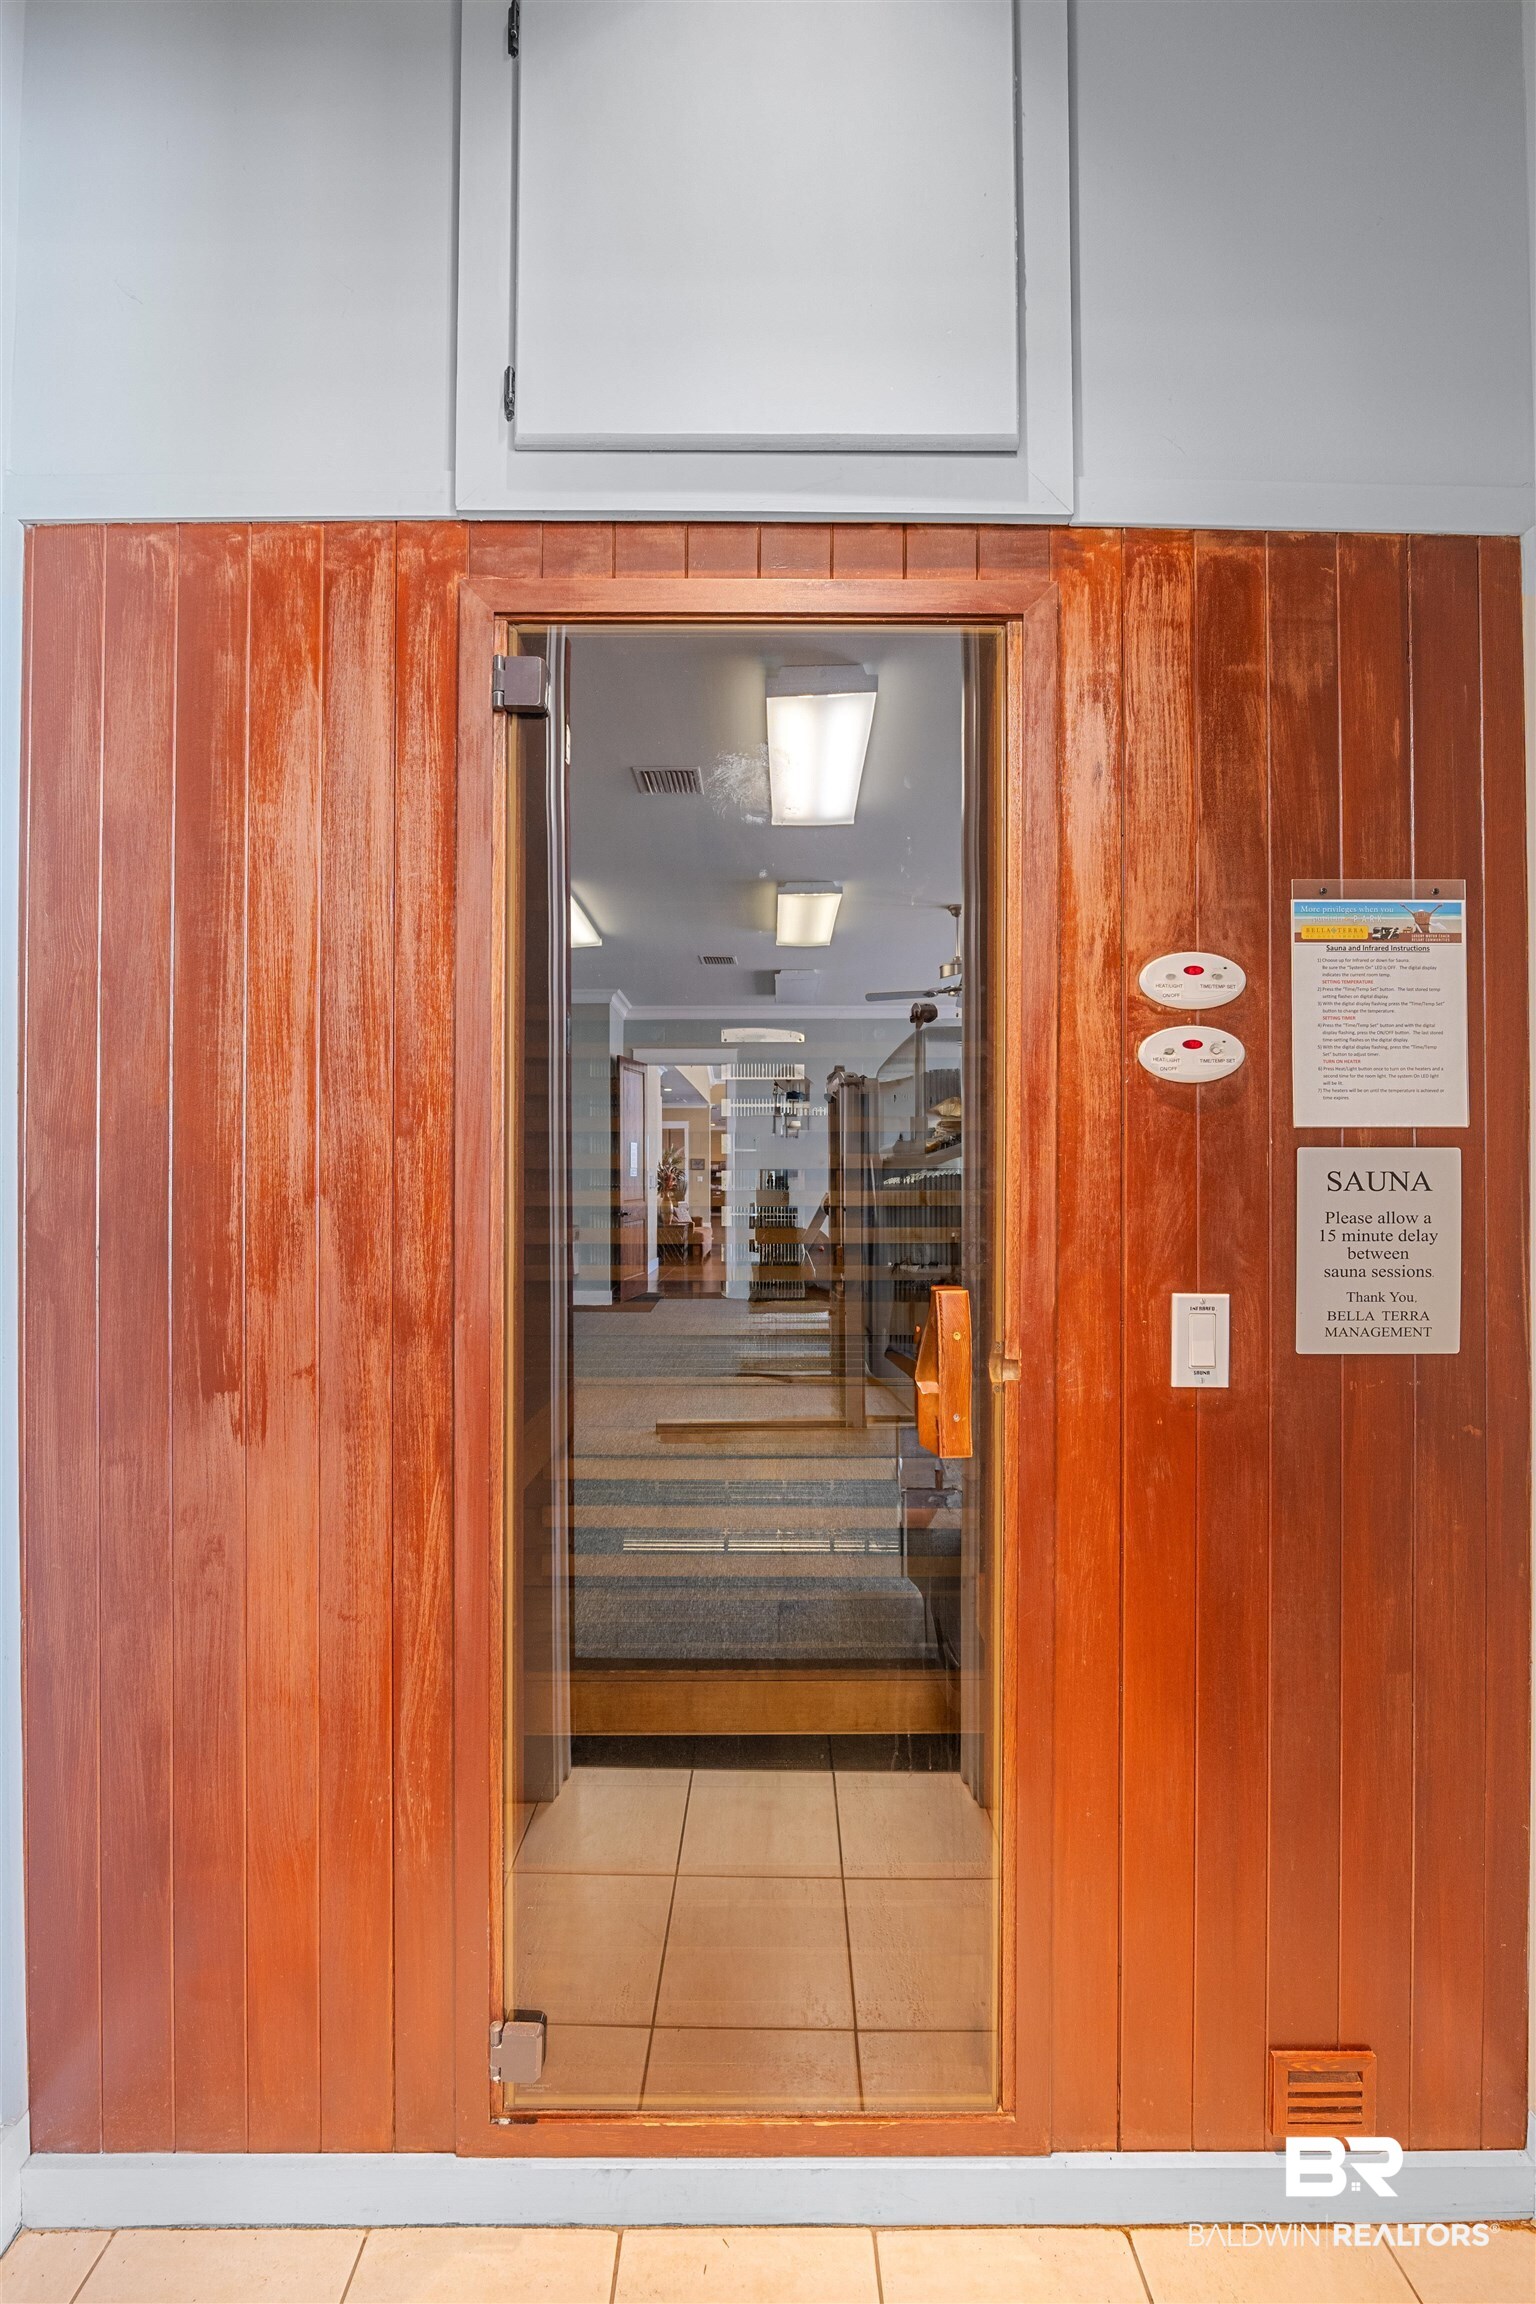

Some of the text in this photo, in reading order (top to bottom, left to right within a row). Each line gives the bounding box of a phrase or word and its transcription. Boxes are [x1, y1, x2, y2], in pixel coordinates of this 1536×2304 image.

[1300, 905, 1320, 913] More
[1322, 905, 1356, 914] privileges
[1358, 905, 1380, 913] when
[1327, 1171, 1432, 1192] SAUNA
[1325, 1212, 1432, 1224] Please allow a
[1320, 1229, 1438, 1245] 15 minute delay
[1348, 1247, 1409, 1260] between
[1324, 1265, 1434, 1278] sauna sessions.
[1346, 1292, 1385, 1303] Thank
[1327, 1311, 1430, 1321] BELLA TERRA
[1325, 1327, 1432, 1337] MANAGEMENT
